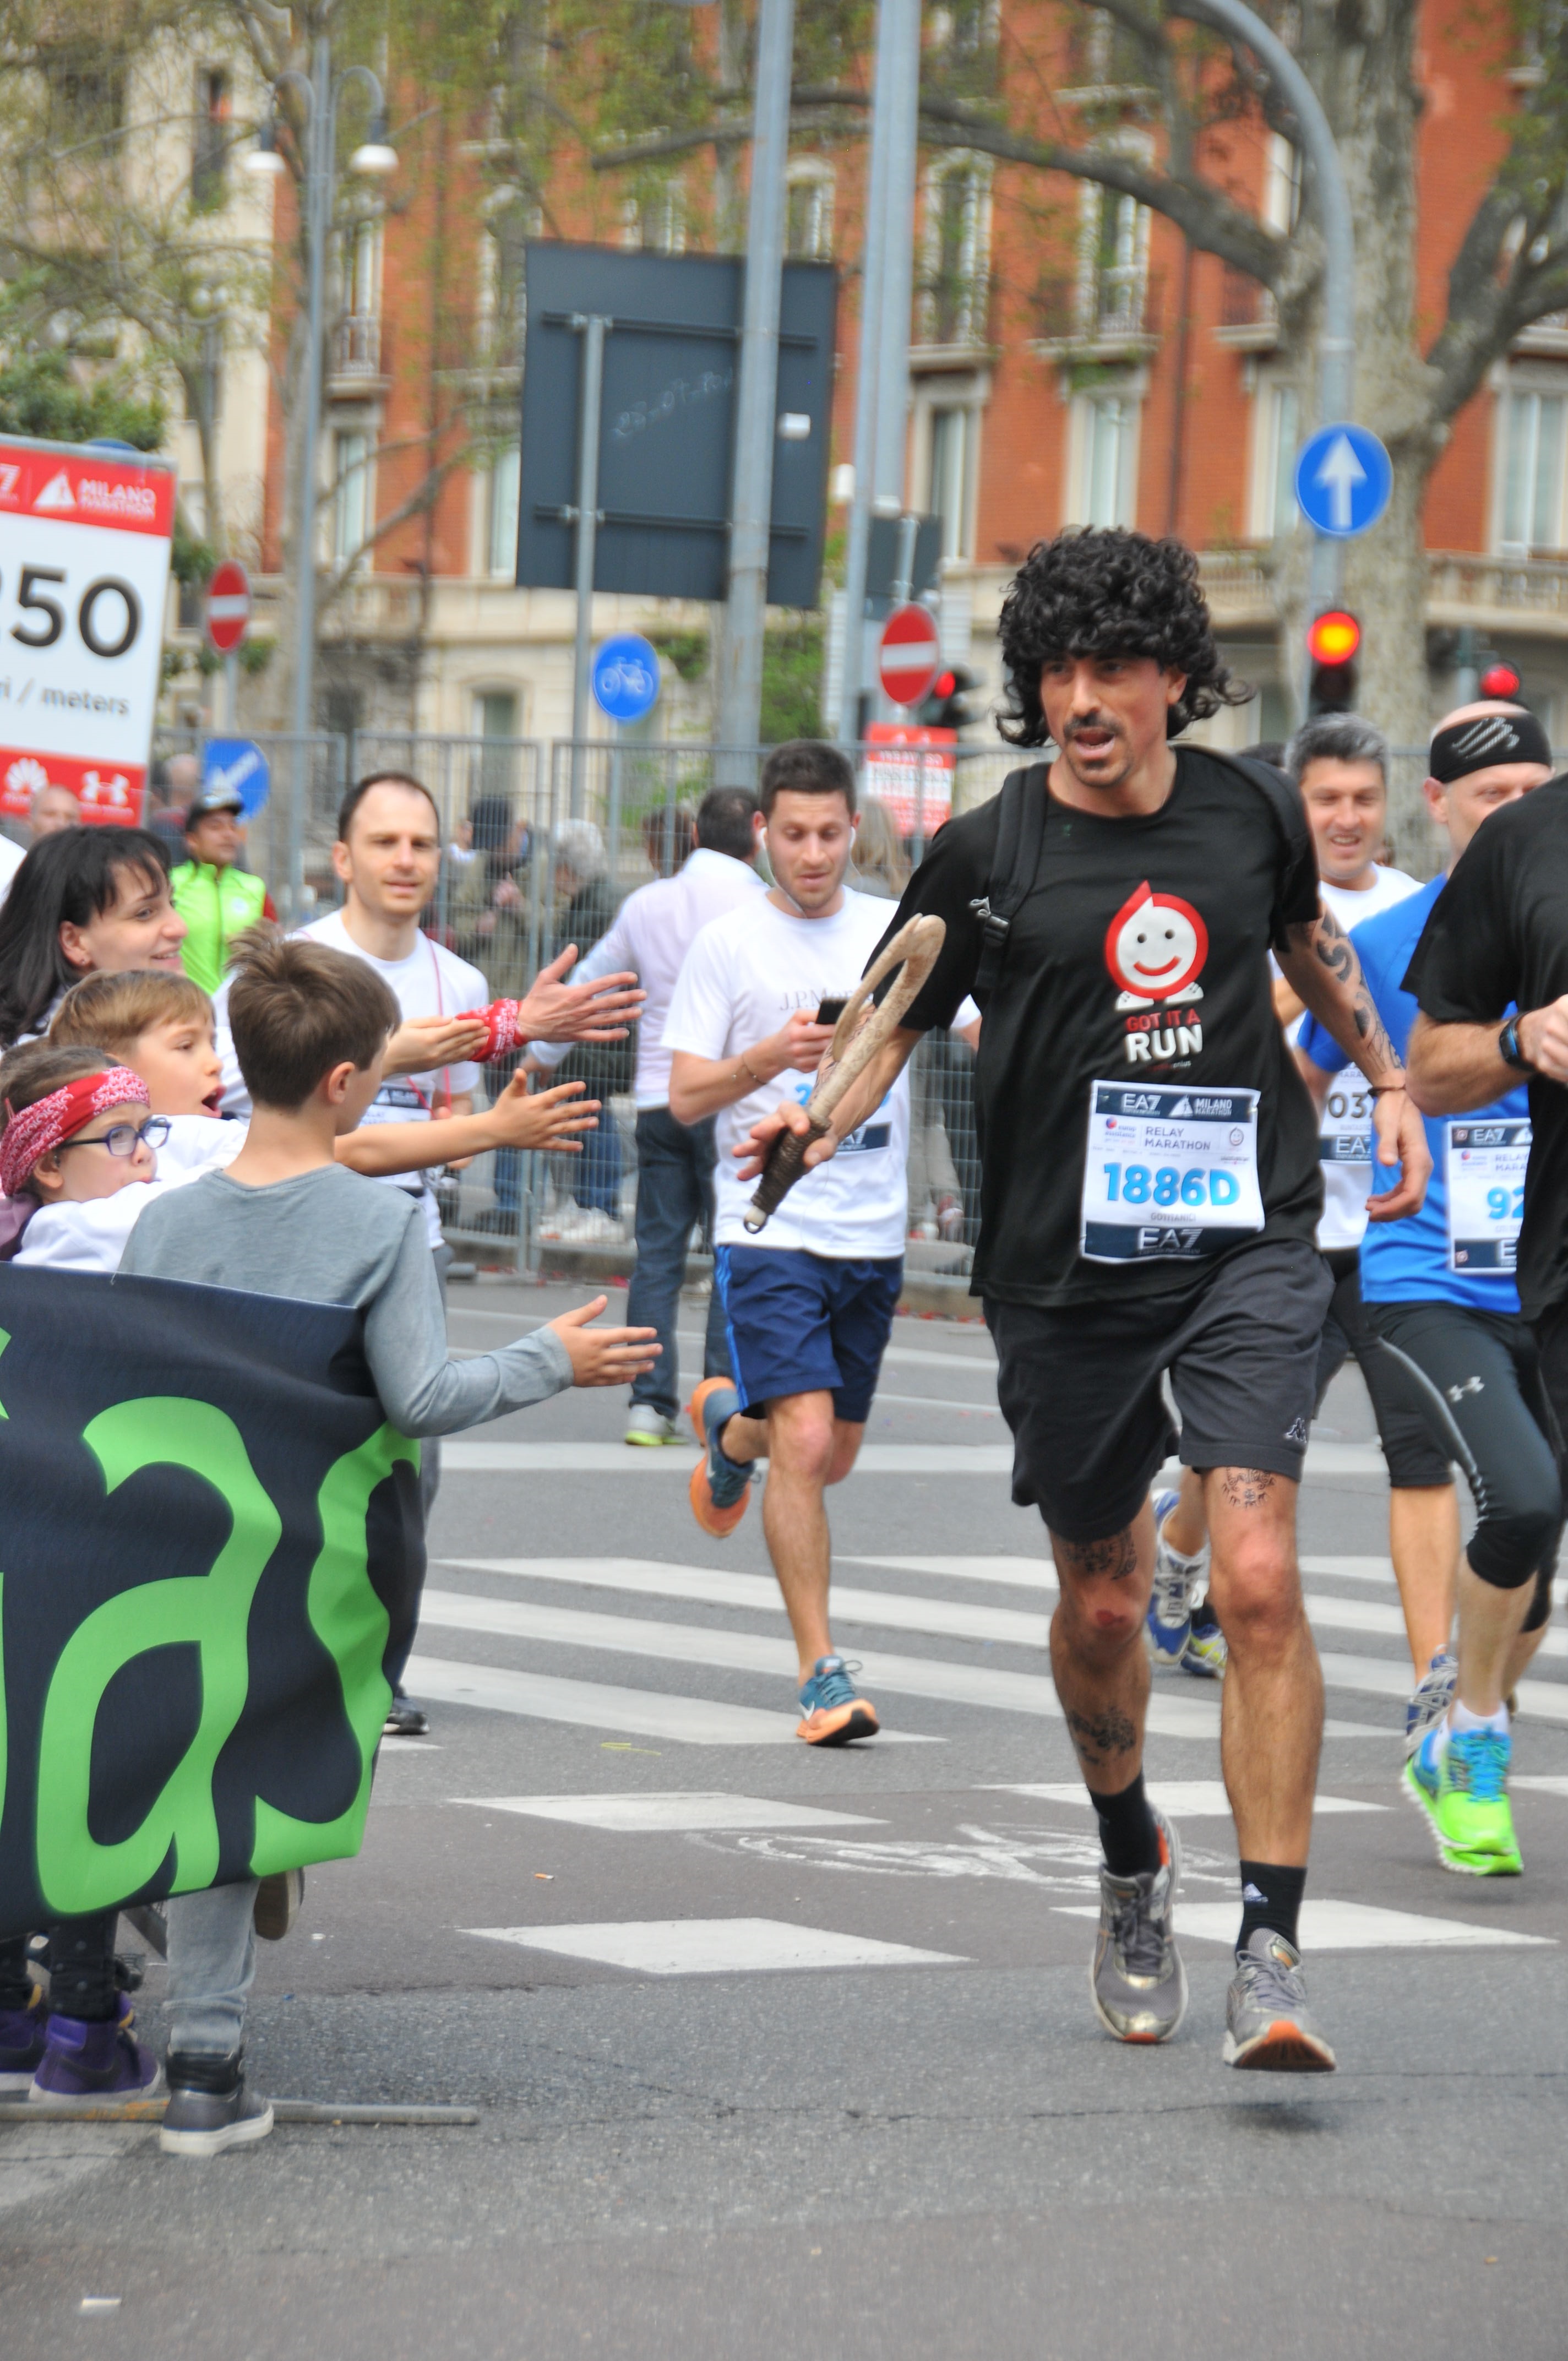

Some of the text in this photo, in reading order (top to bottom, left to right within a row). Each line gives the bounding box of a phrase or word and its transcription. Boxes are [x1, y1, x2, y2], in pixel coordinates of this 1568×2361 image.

[78, 478, 157, 505] MILANO
[0, 562, 144, 659] 50
[40, 687, 130, 716] meters
[1126, 1008, 1201, 1032] GOT IT A
[1125, 1024, 1203, 1063] RUN
[1122, 1092, 1162, 1110] EA7
[1195, 1098, 1233, 1109] MILANO
[1195, 1106, 1232, 1116] MARATHON
[1328, 1092, 1372, 1119] 03
[1146, 1127, 1185, 1137] RELAY
[1473, 1128, 1506, 1143] EA7
[1145, 1139, 1211, 1151] MARATHON
[1495, 1154, 1528, 1162] RELAY
[1495, 1163, 1527, 1172] MARA
[1104, 1162, 1240, 1206] 1886D
[1487, 1186, 1524, 1220] 92
[1138, 1227, 1203, 1250] EA7
